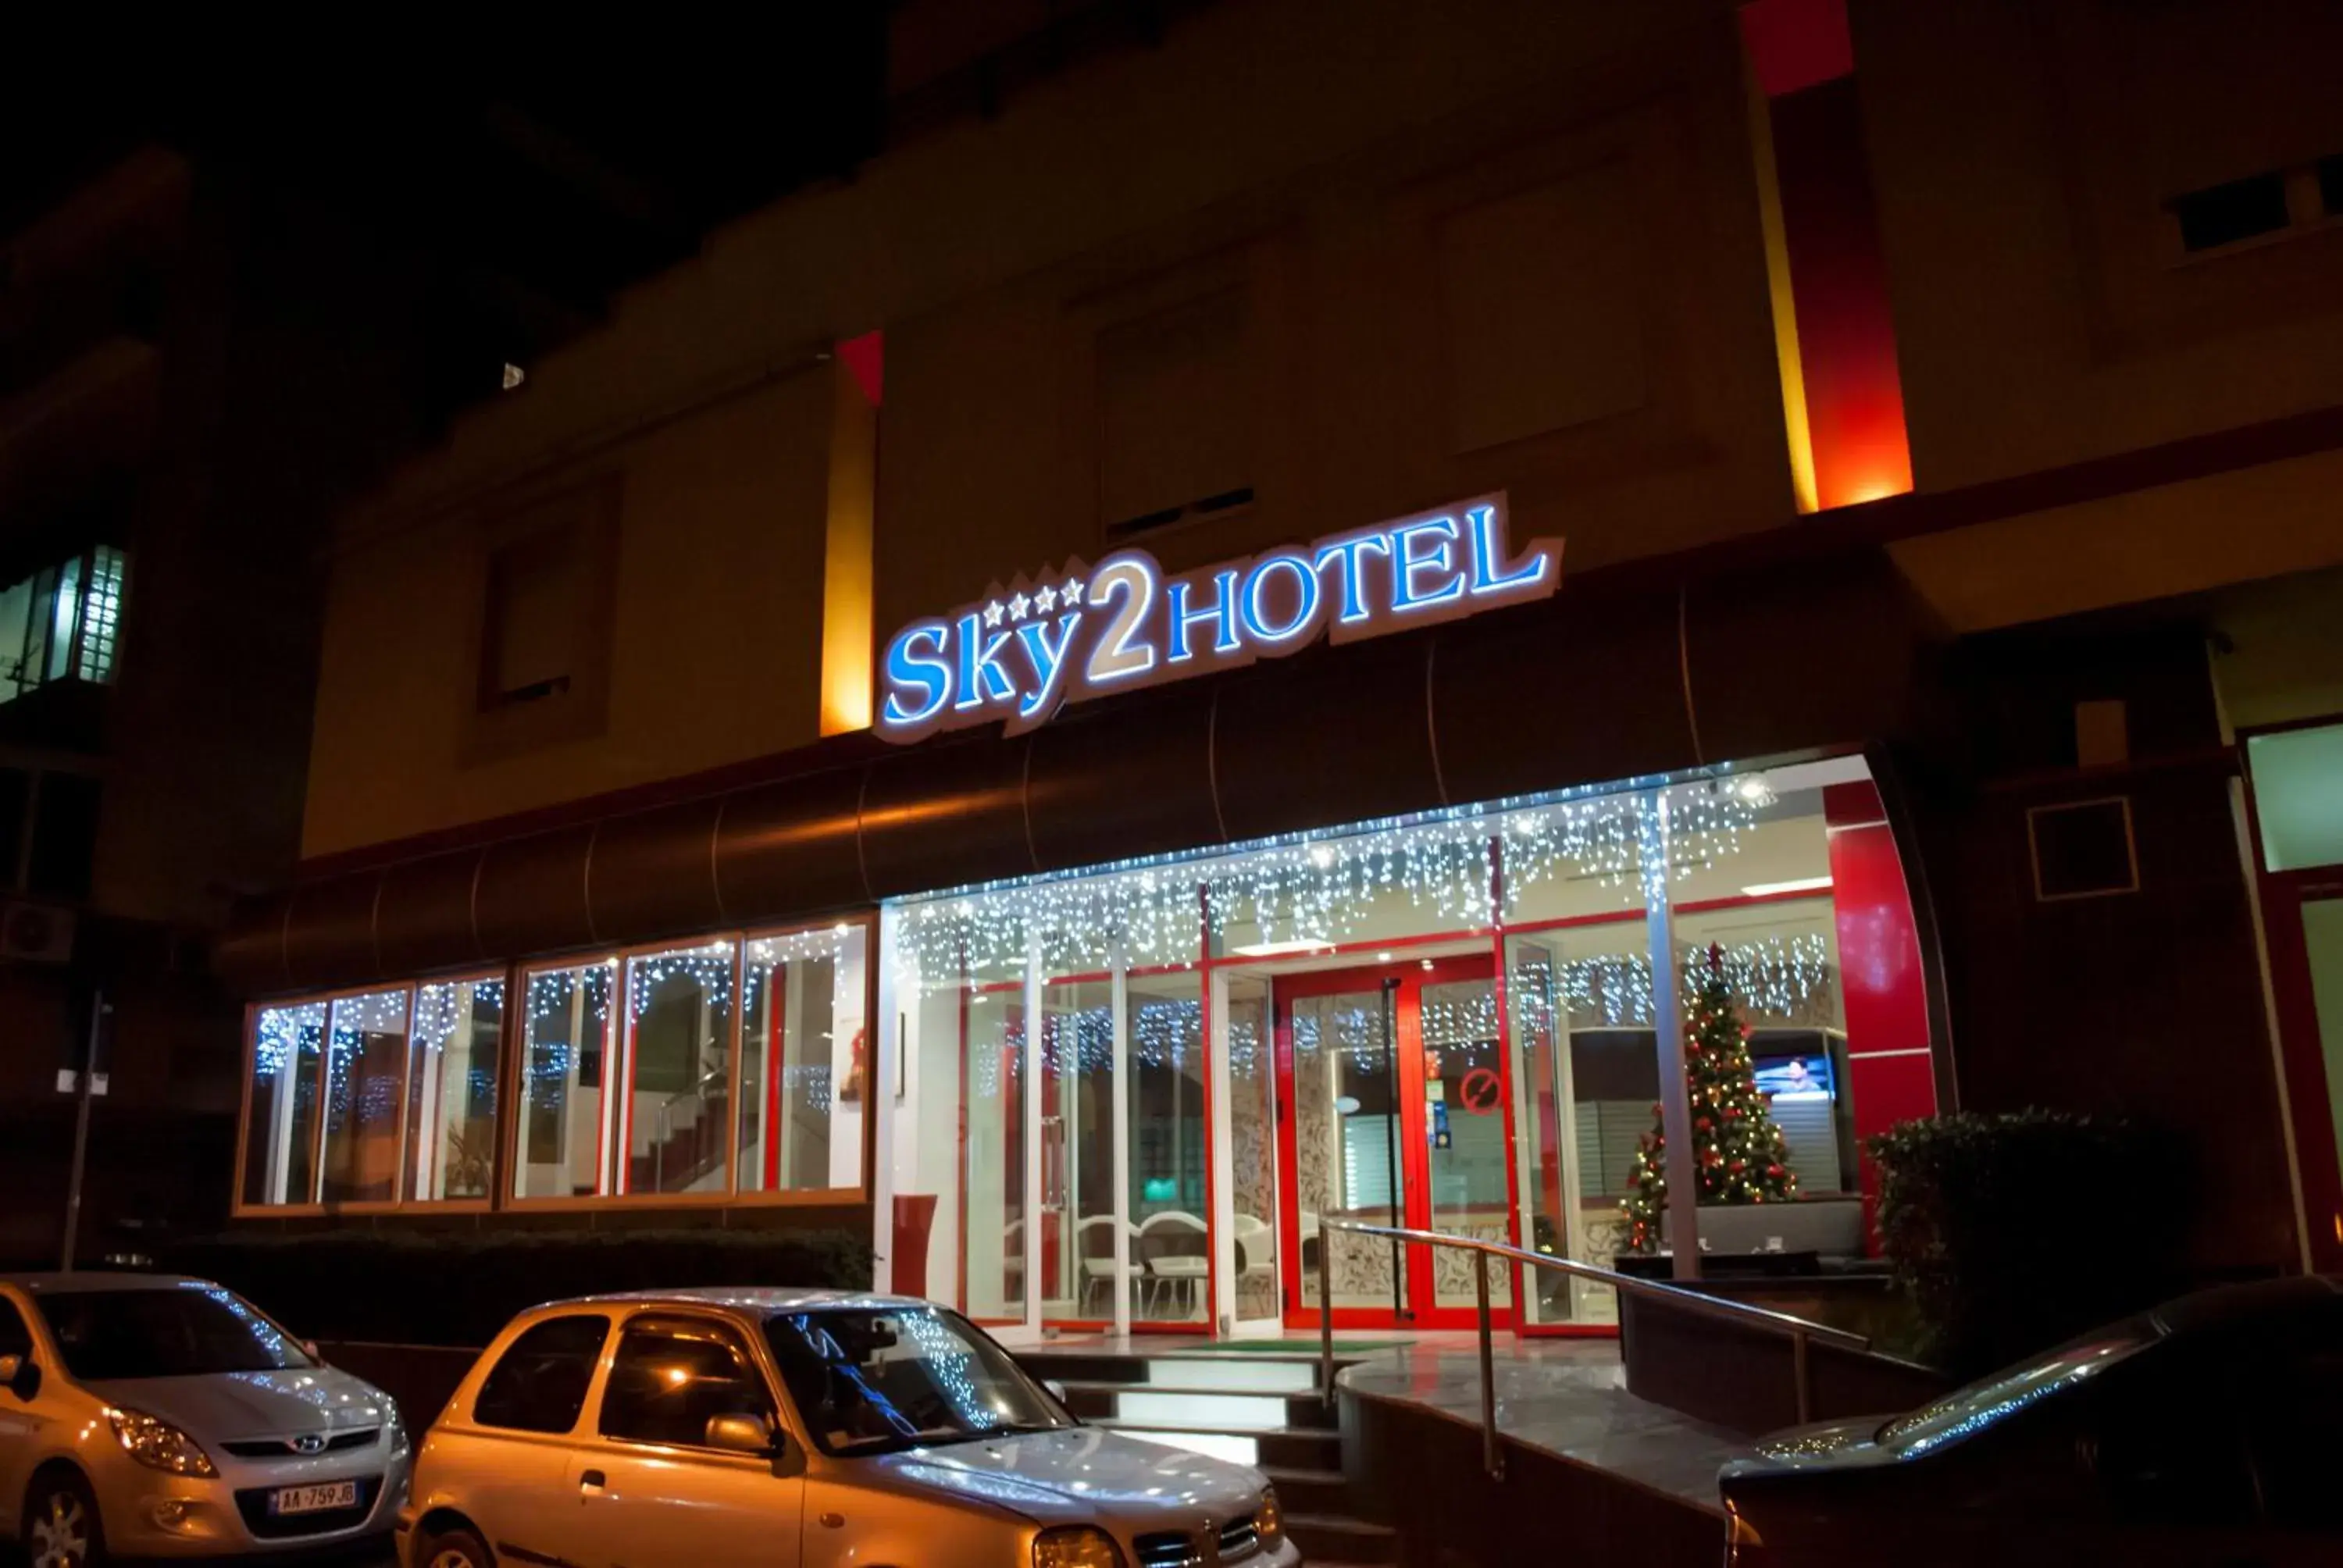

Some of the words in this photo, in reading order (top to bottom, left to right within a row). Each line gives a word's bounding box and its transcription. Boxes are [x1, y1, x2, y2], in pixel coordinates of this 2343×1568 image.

[884, 611, 1082, 725] Sky
[1088, 560, 1154, 682] 2
[1168, 505, 1547, 661] HOTEL
